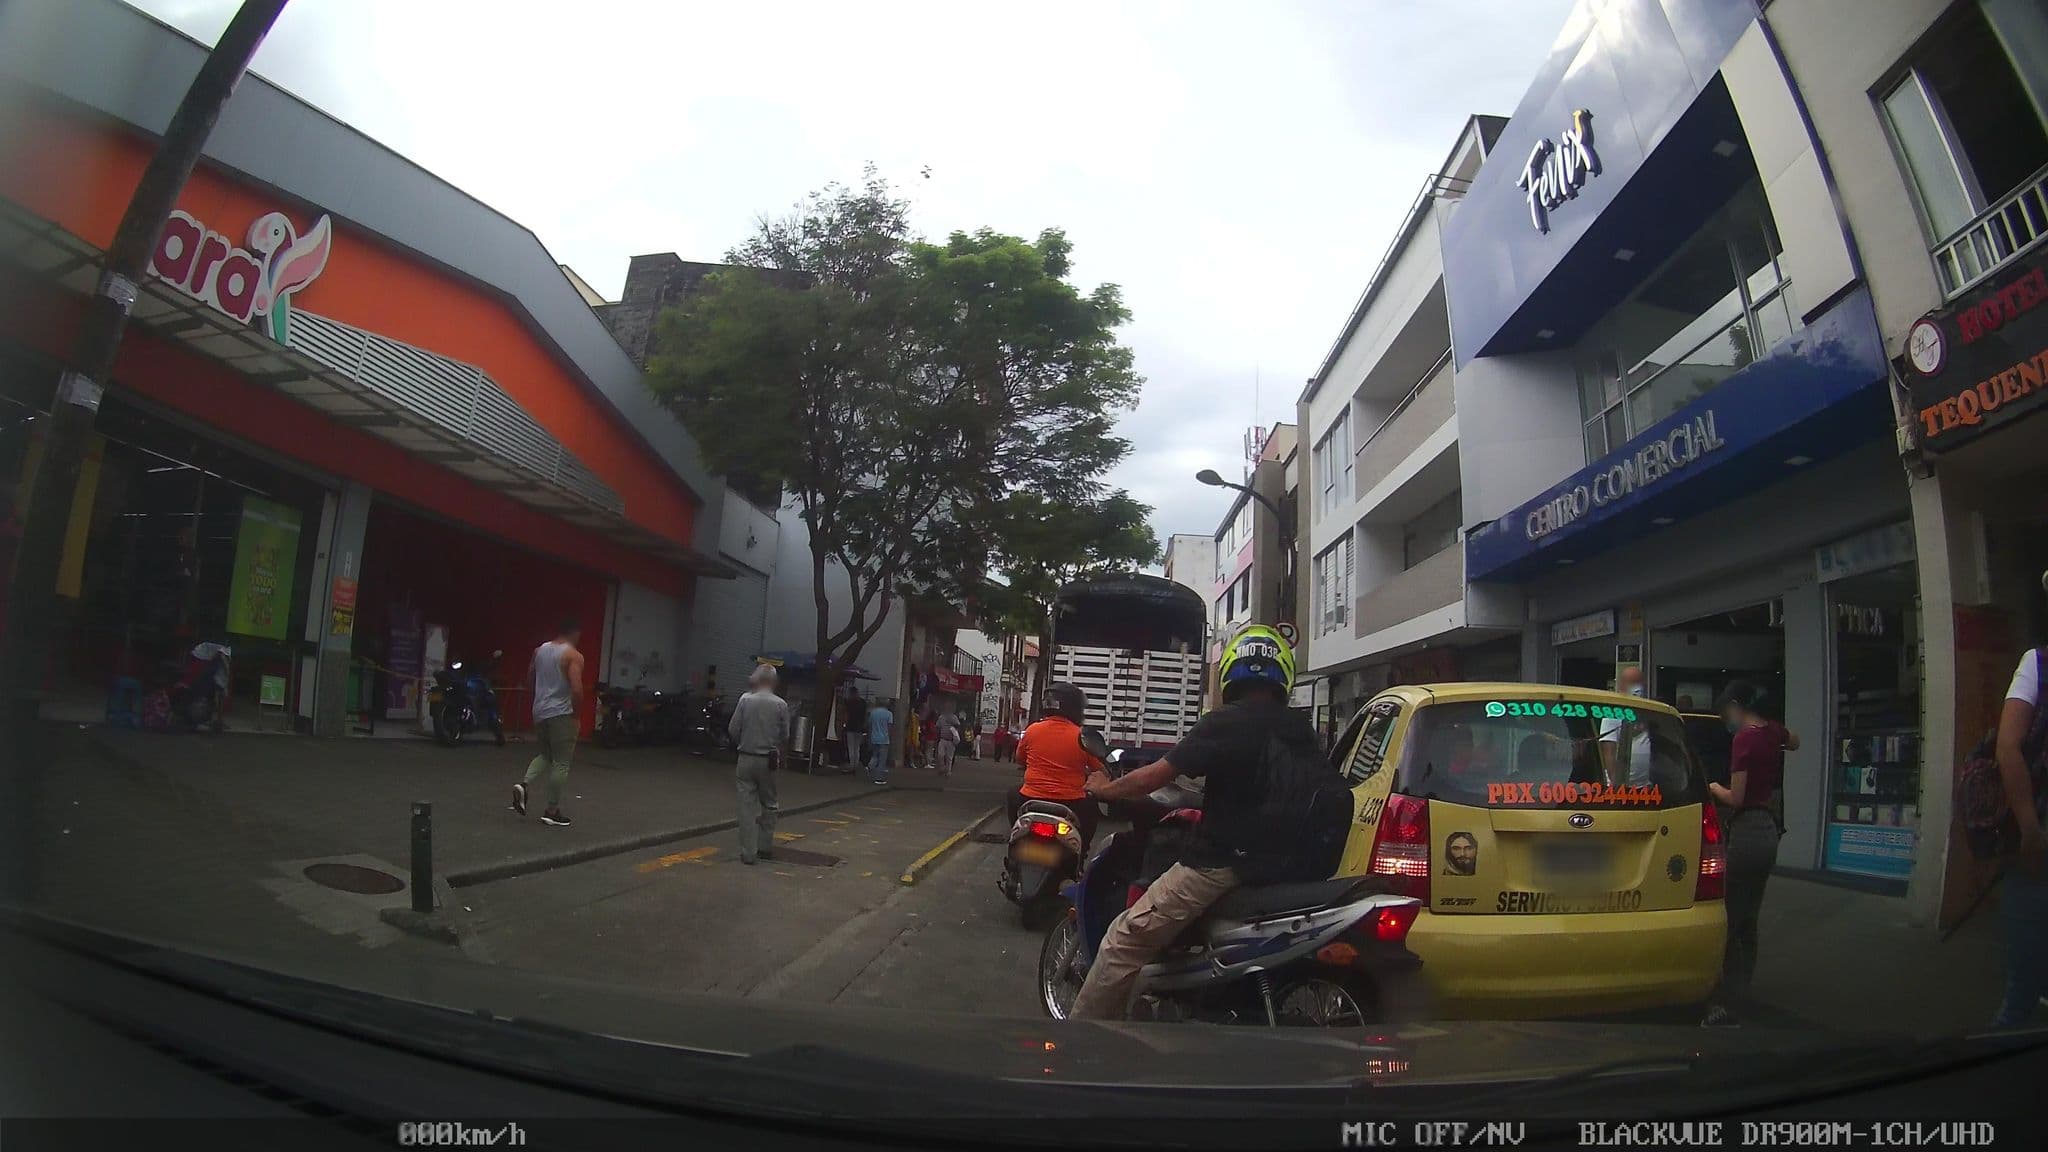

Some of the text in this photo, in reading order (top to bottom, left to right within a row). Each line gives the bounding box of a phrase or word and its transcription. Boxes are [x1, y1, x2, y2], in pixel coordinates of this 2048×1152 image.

[151, 213, 263, 322] ara
[1525, 409, 1726, 541] CENTRO COMERCIAL
[1507, 702, 1637, 722] 310 428 8888
[1487, 782, 1662, 805] PBX 606 3244444
